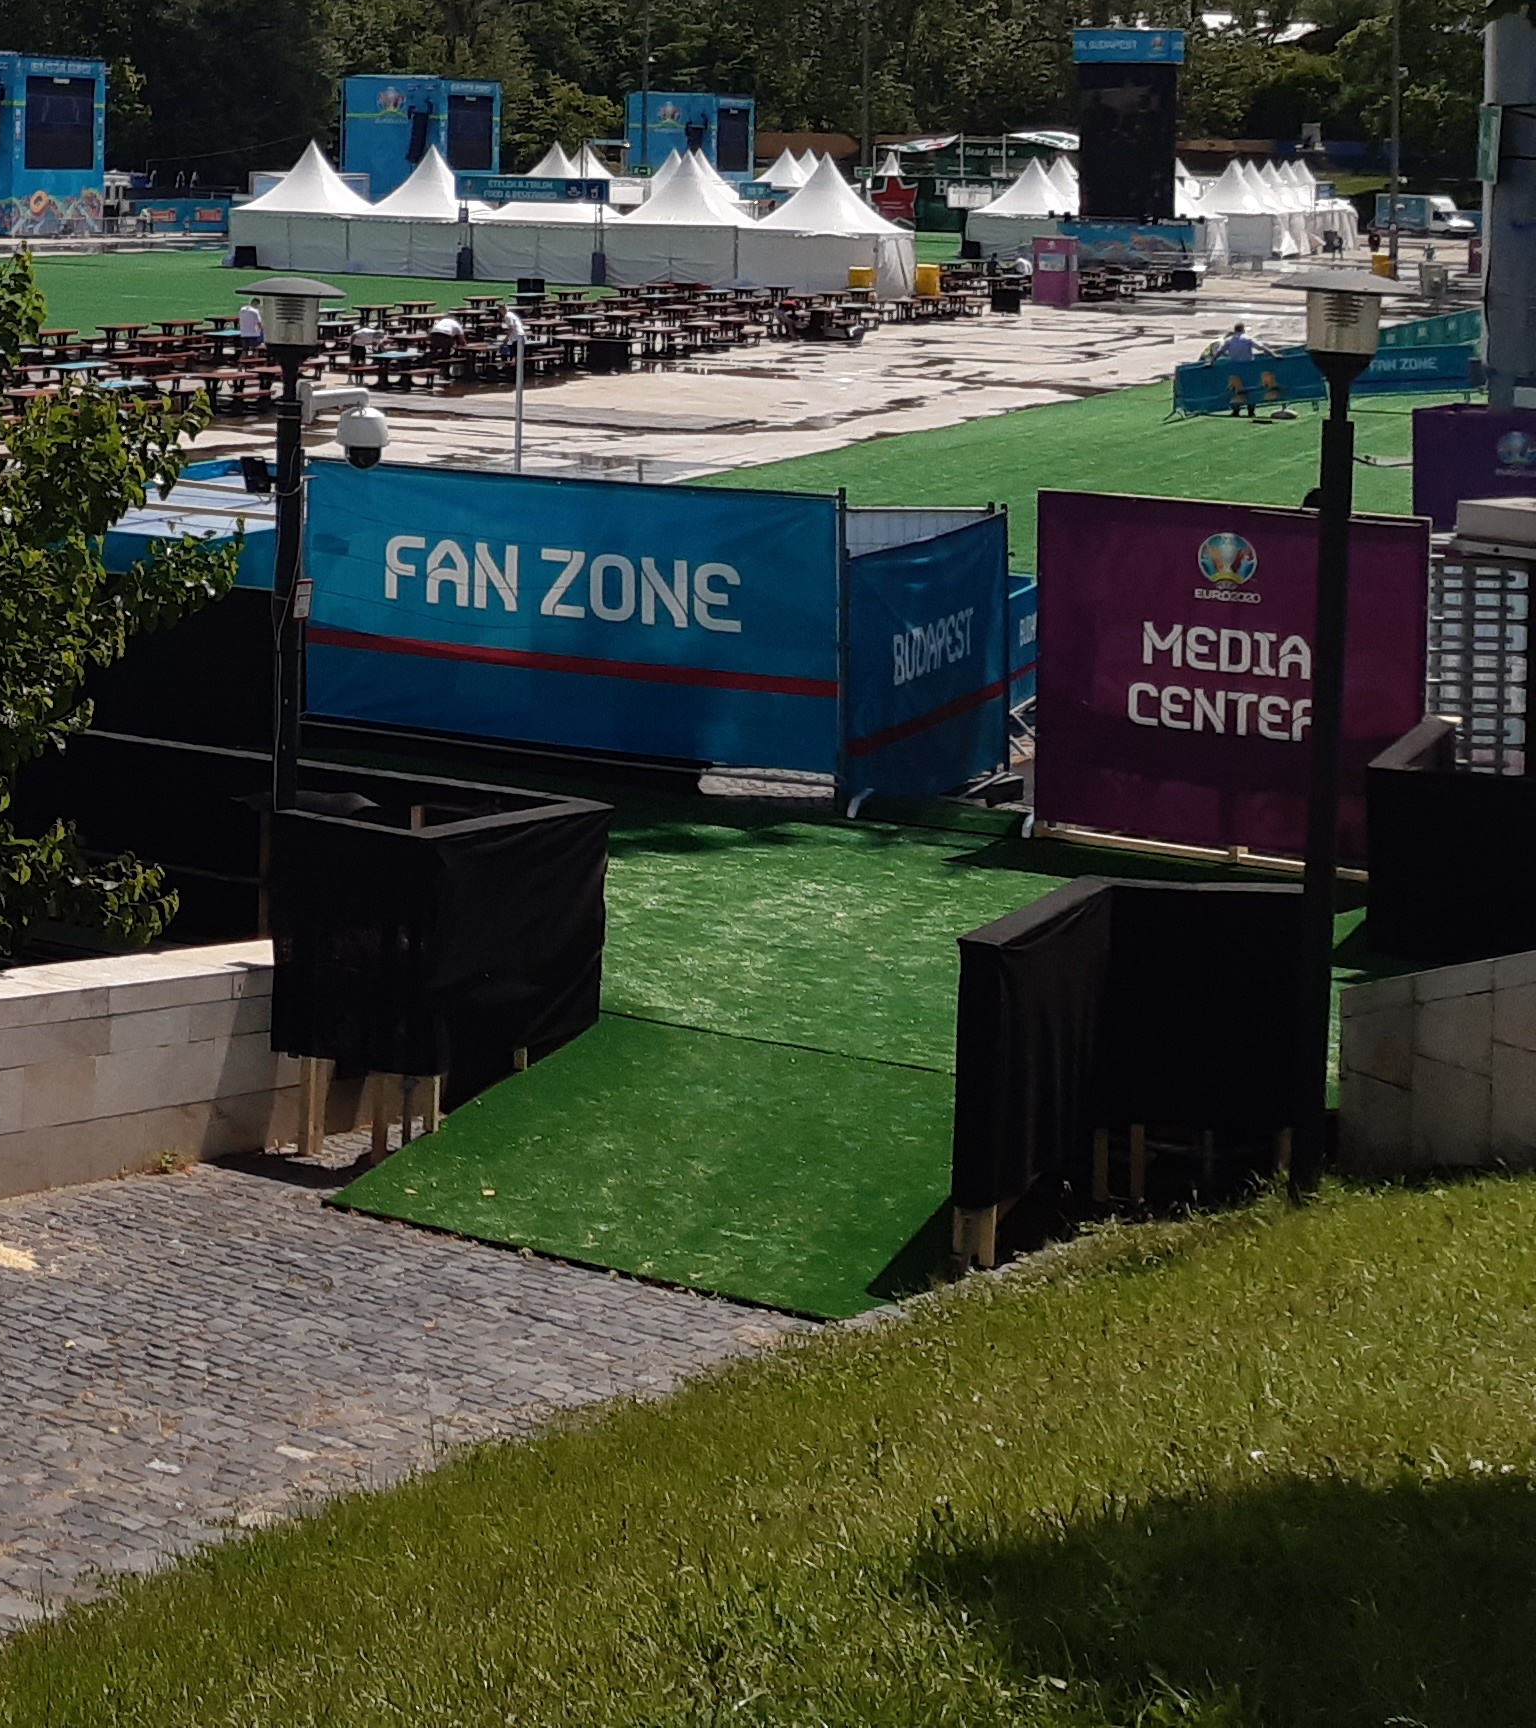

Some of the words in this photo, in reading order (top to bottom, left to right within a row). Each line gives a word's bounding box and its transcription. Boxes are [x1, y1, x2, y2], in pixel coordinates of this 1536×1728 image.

[1400, 357, 1438, 371] ZONE
[384, 534, 520, 613] FAN
[539, 547, 743, 634] ZONE
[1194, 587, 1262, 604] EURO2020
[893, 607, 975, 687] BUDAPEST
[1142, 621, 1312, 681] MEDIA
